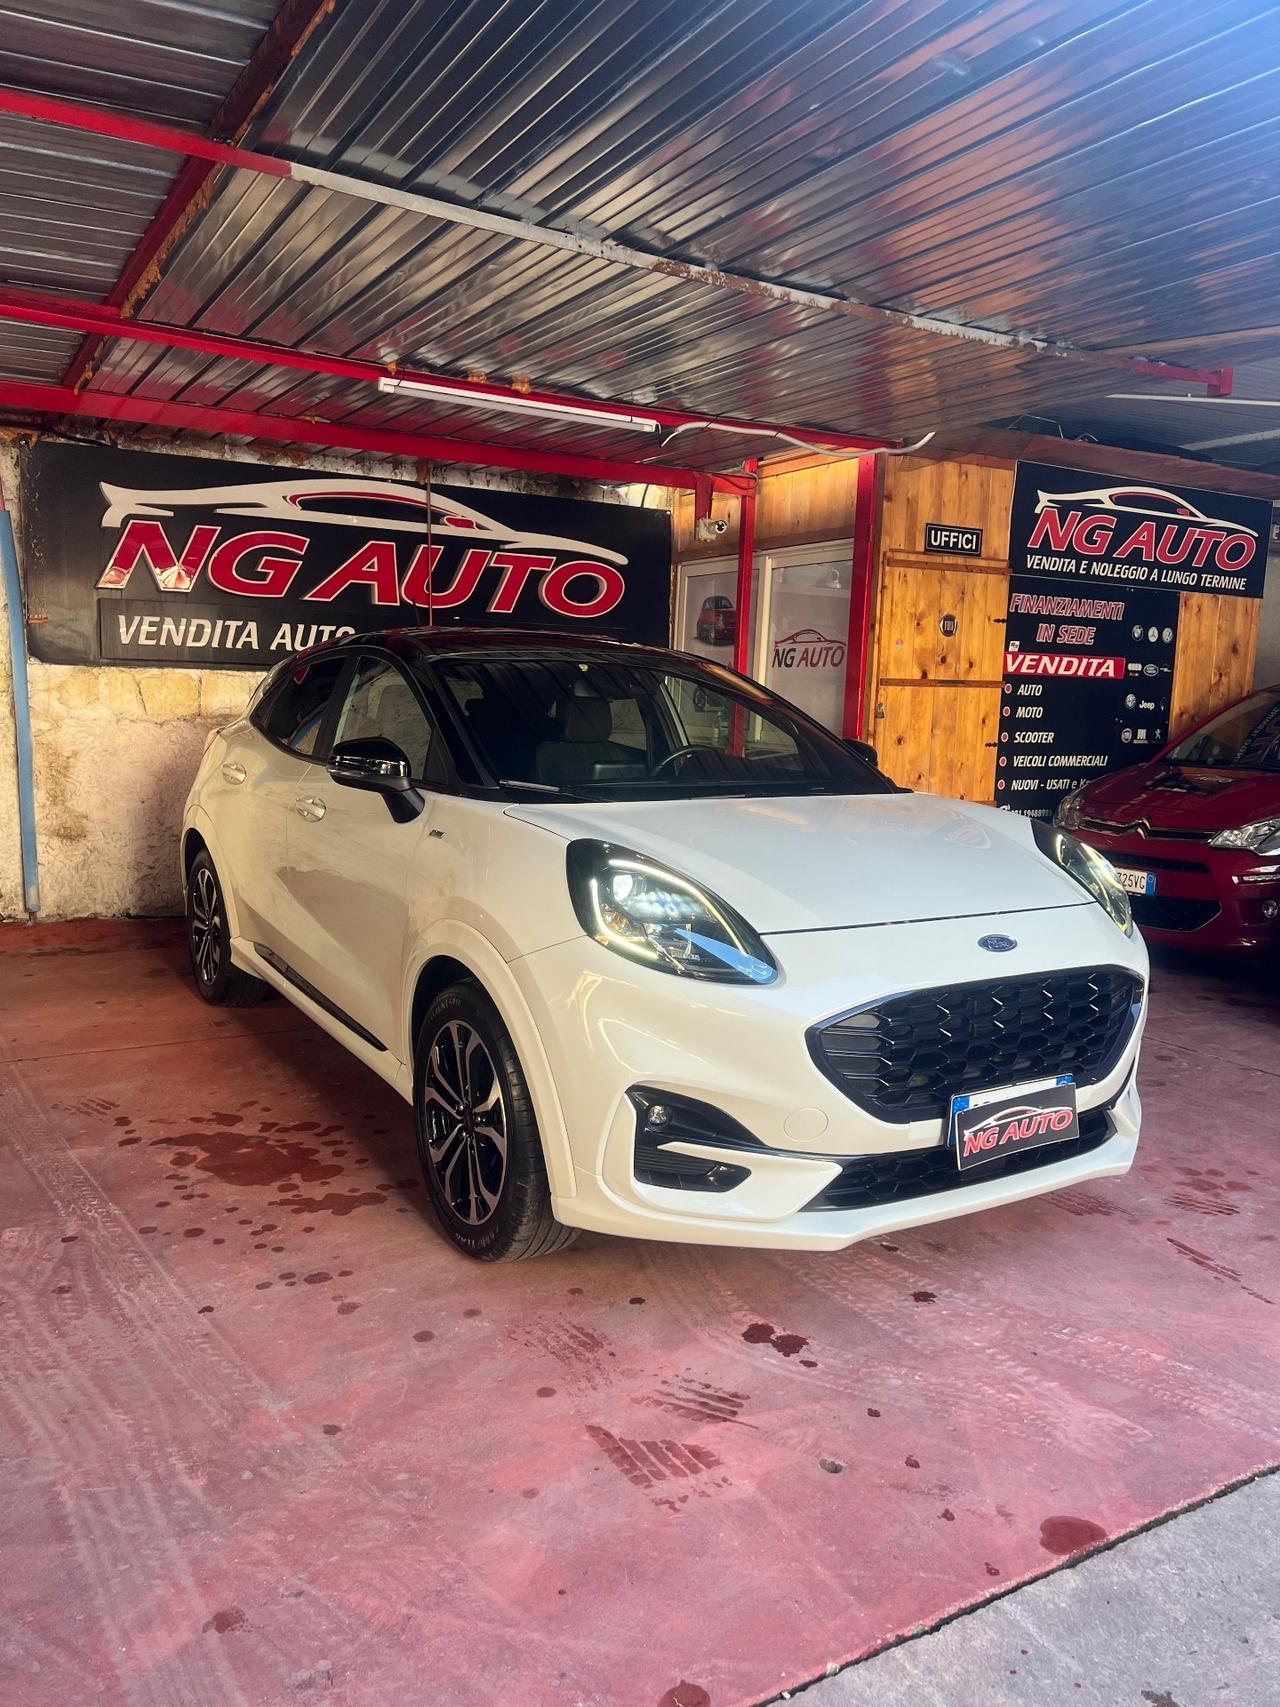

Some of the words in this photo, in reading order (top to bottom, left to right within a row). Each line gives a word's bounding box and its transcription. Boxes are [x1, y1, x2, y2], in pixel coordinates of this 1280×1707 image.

[931, 530, 976, 549] UFFICI
[1027, 507, 1118, 556] NG
[1113, 522, 1256, 571] AUTO
[97, 521, 309, 598] NG
[304, 541, 625, 618] AUTO
[1026, 554, 1076, 573] VENDITA
[1079, 560, 1088, 575] E
[1090, 561, 1149, 581] NOLEGGIO
[1150, 568, 1159, 582] A
[1161, 568, 1198, 586] LUNGO
[1200, 574, 1247, 591] TERMINE
[1009, 593, 1125, 621] FINANZIAMENTI
[118, 614, 260, 650] VENDITA
[1036, 623, 1056, 643] IN
[1056, 625, 1096, 645] SEDE
[771, 647, 797, 668] NG
[796, 645, 846, 668] AUTO
[1005, 653, 1116, 678] VENDITA
[1017, 684, 1043, 697] AUTO
[1015, 706, 1043, 718] MOTO
[1013, 732, 1054, 743] SCOOTER
[1013, 755, 1046, 768] VEICOLI
[1048, 755, 1108, 767] COMMERCIALI
[1010, 779, 1038, 790] NUOVI
[1046, 779, 1070, 790] USATI
[1071, 780, 1078, 790] e
[963, 1126, 1000, 1158] NG
[998, 1109, 1073, 1144] AUTO
